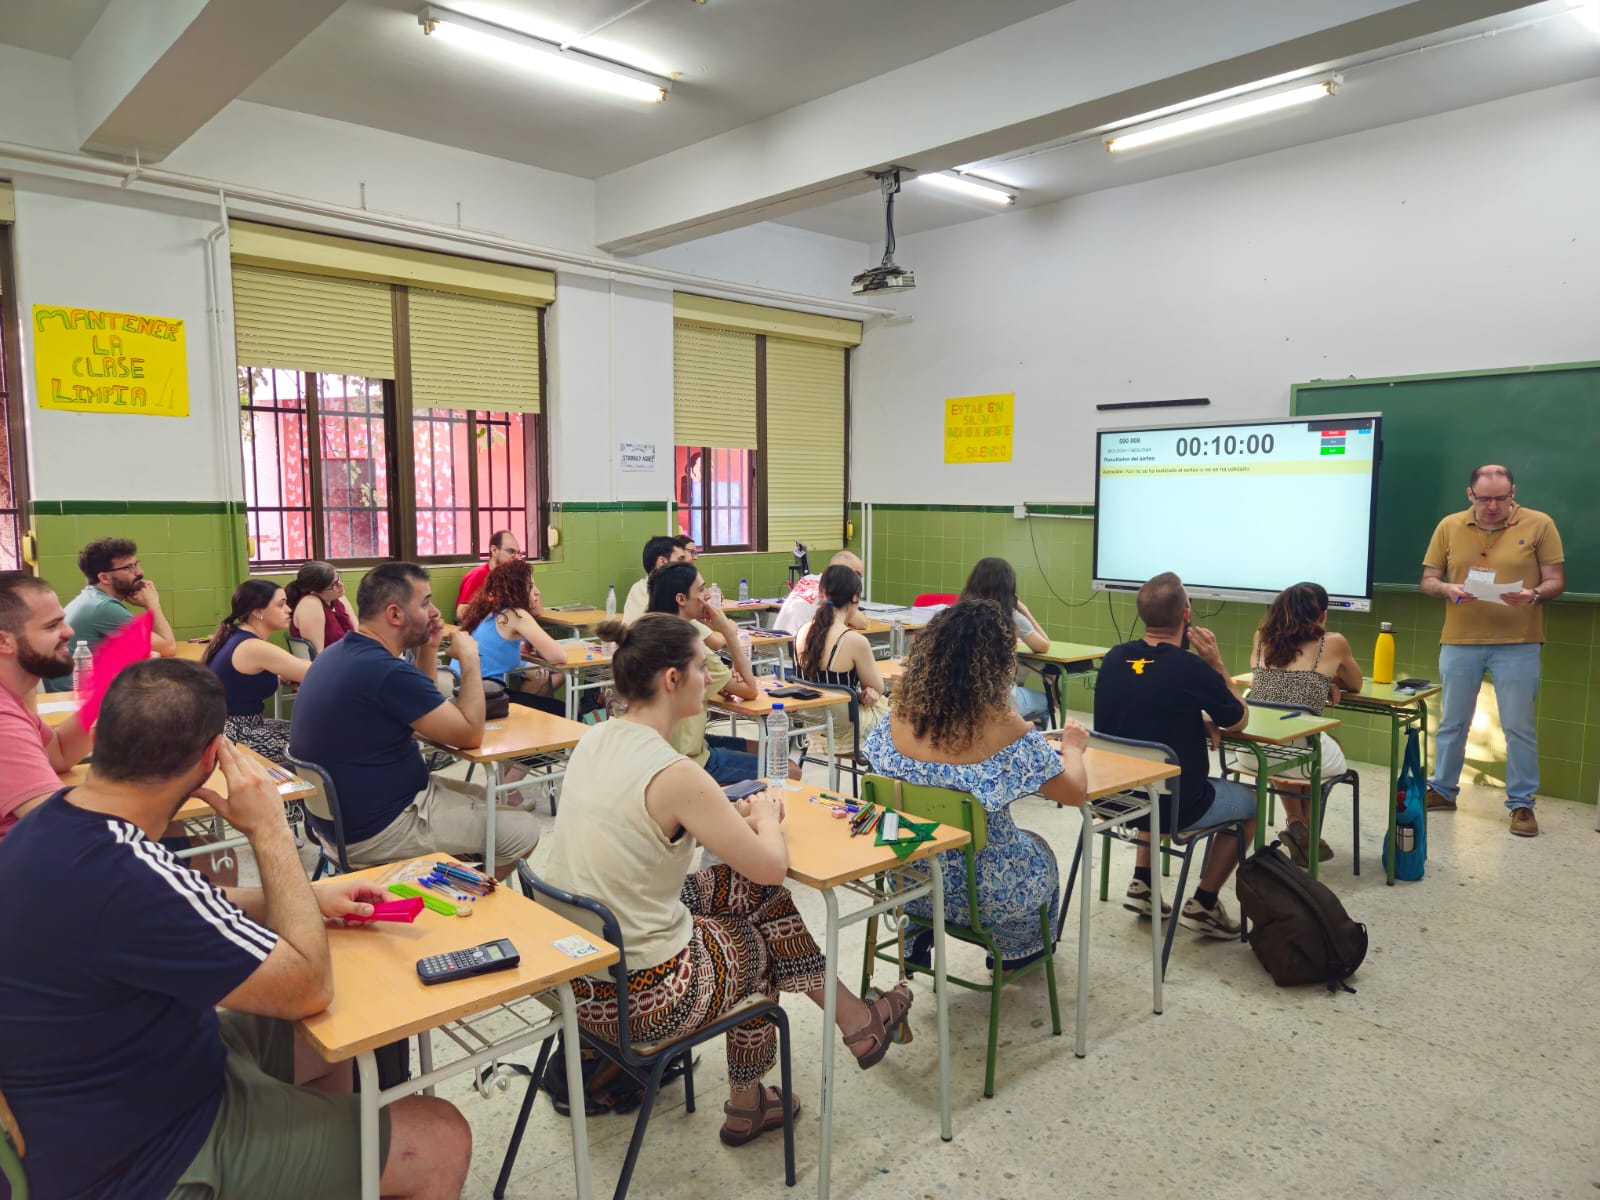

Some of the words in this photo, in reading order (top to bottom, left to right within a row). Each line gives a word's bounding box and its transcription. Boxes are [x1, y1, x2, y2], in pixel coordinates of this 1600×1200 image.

[36, 308, 179, 342] MANTENER
[92, 335, 124, 356] LA
[71, 356, 145, 379] CLASE
[51, 378, 147, 407] LIMPIA
[987, 401, 1004, 413] EN
[1176, 433, 1275, 457] 00:10:00
